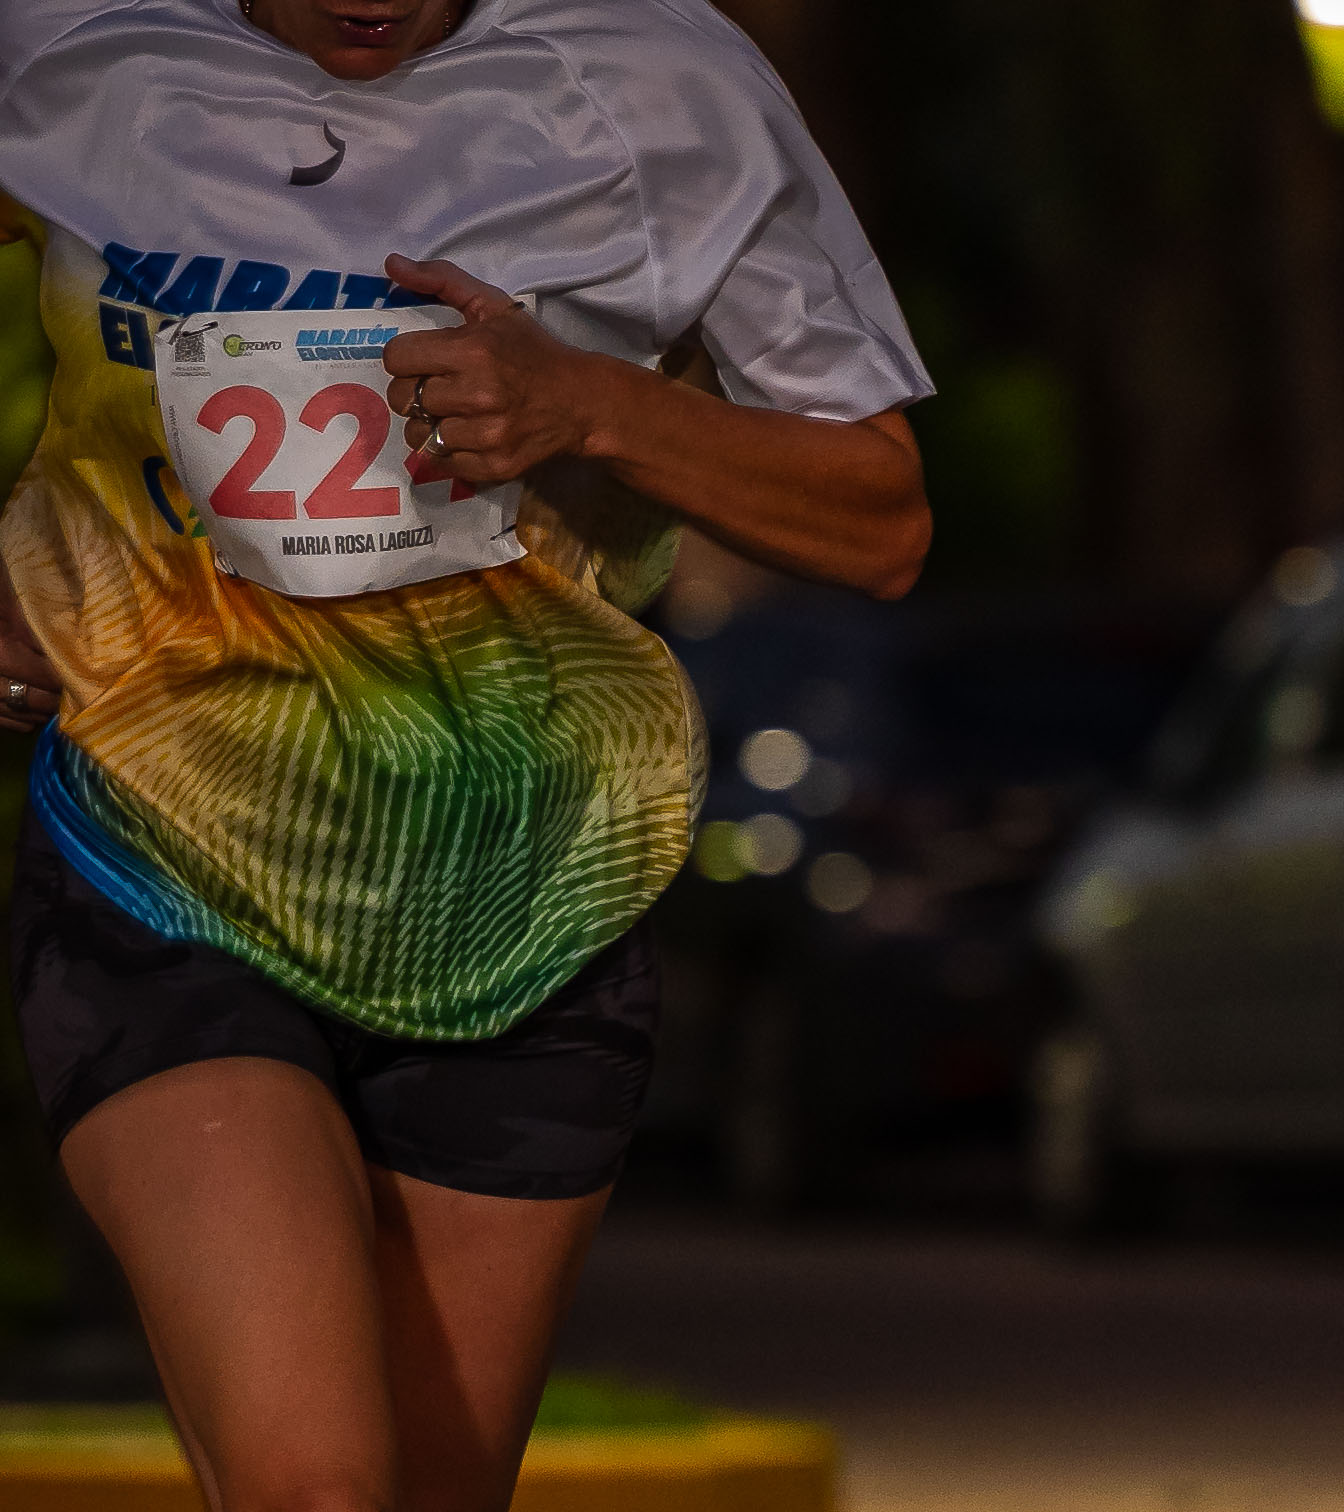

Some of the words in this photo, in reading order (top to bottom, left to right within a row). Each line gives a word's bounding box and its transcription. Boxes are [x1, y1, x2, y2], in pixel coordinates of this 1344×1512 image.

[100, 241, 441, 317] MARAT
[281, 536, 332, 556] MARIA
[335, 534, 376, 555] ROSA
